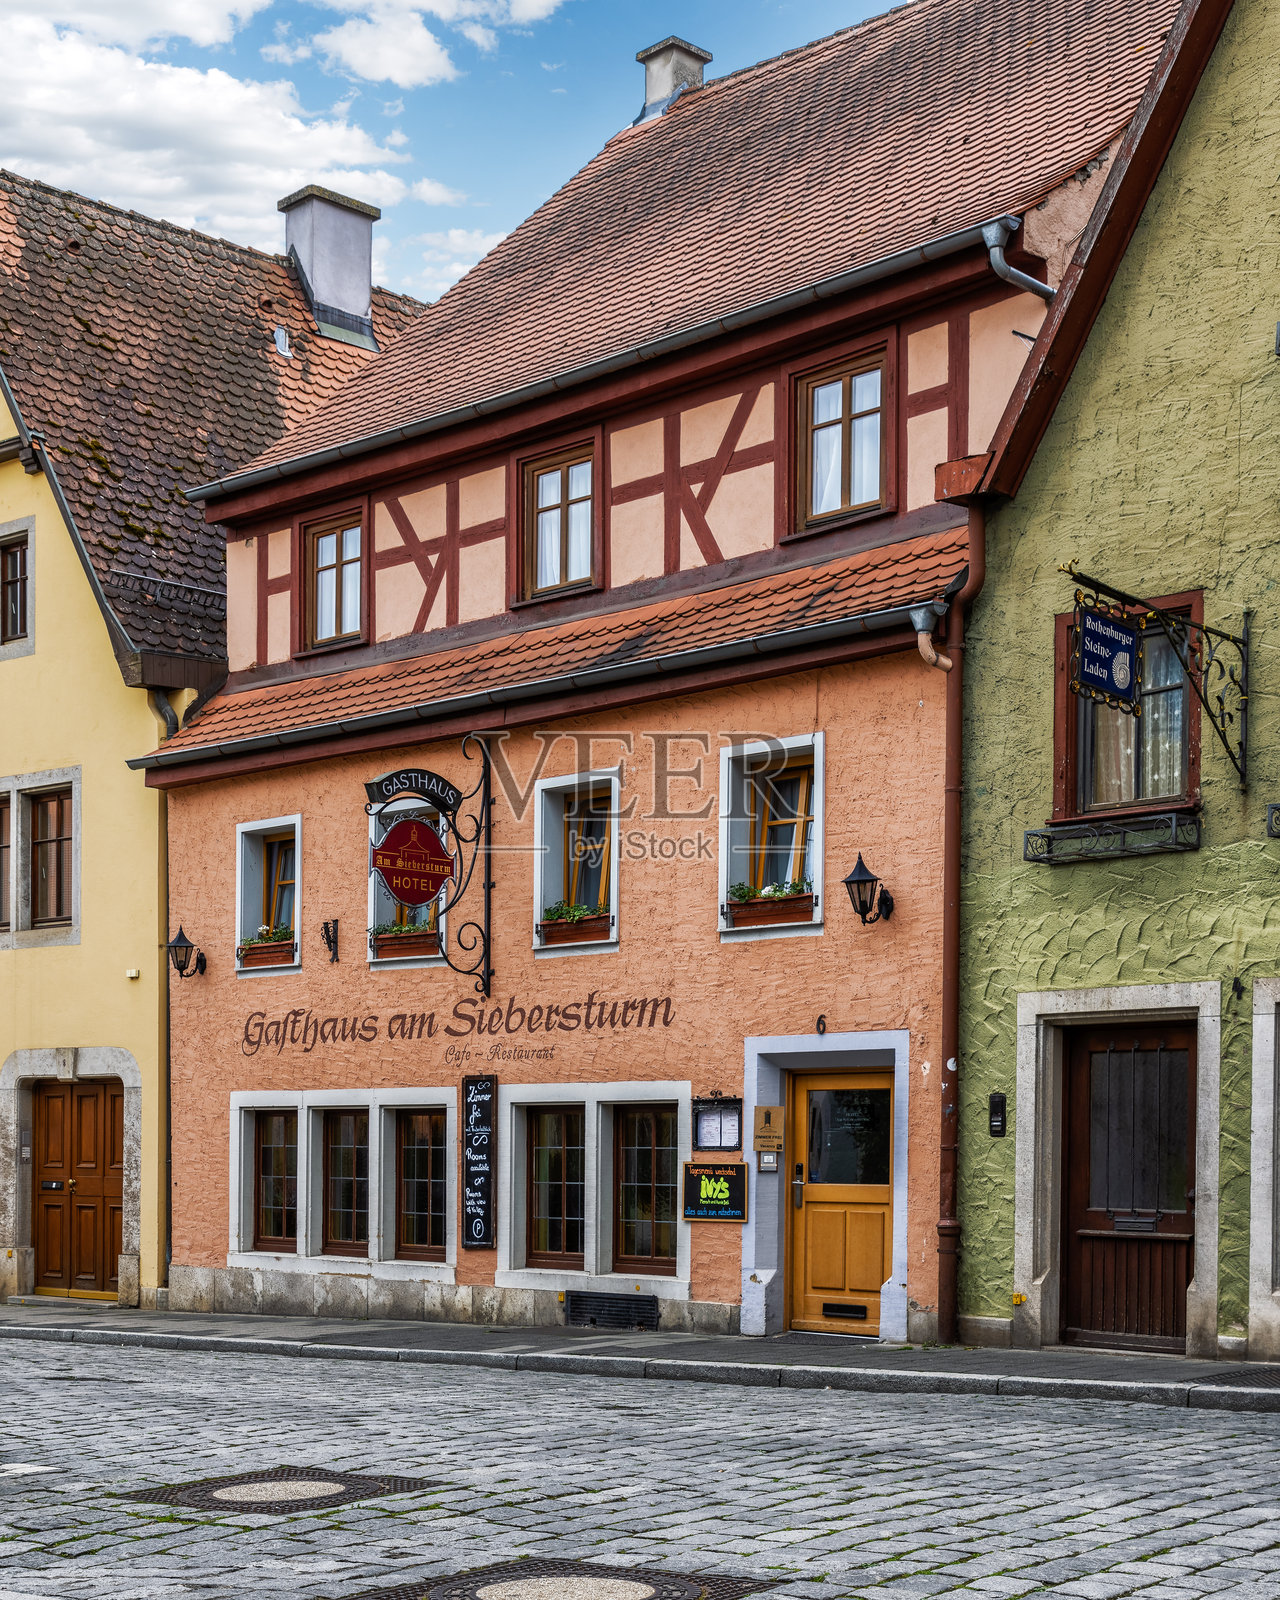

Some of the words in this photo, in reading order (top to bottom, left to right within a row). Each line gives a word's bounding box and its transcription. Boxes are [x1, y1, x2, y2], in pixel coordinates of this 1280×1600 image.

[1085, 615, 1134, 646] Rothenburger
[1084, 636, 1112, 658] Steine-
[1084, 658, 1108, 681] Laden
[382, 773, 457, 804] GASTHAUS
[376, 855, 391, 867] Am
[396, 857, 451, 873] Siebersturm
[393, 875, 436, 892] HOTEL
[388, 1012, 439, 1040] am
[444, 990, 676, 1037] Siebersturm
[816, 1014, 826, 1035] 6
[445, 1044, 471, 1067] Cafe
[486, 1043, 555, 1061] Restaurant
[466, 1148, 487, 1160] Rooms
